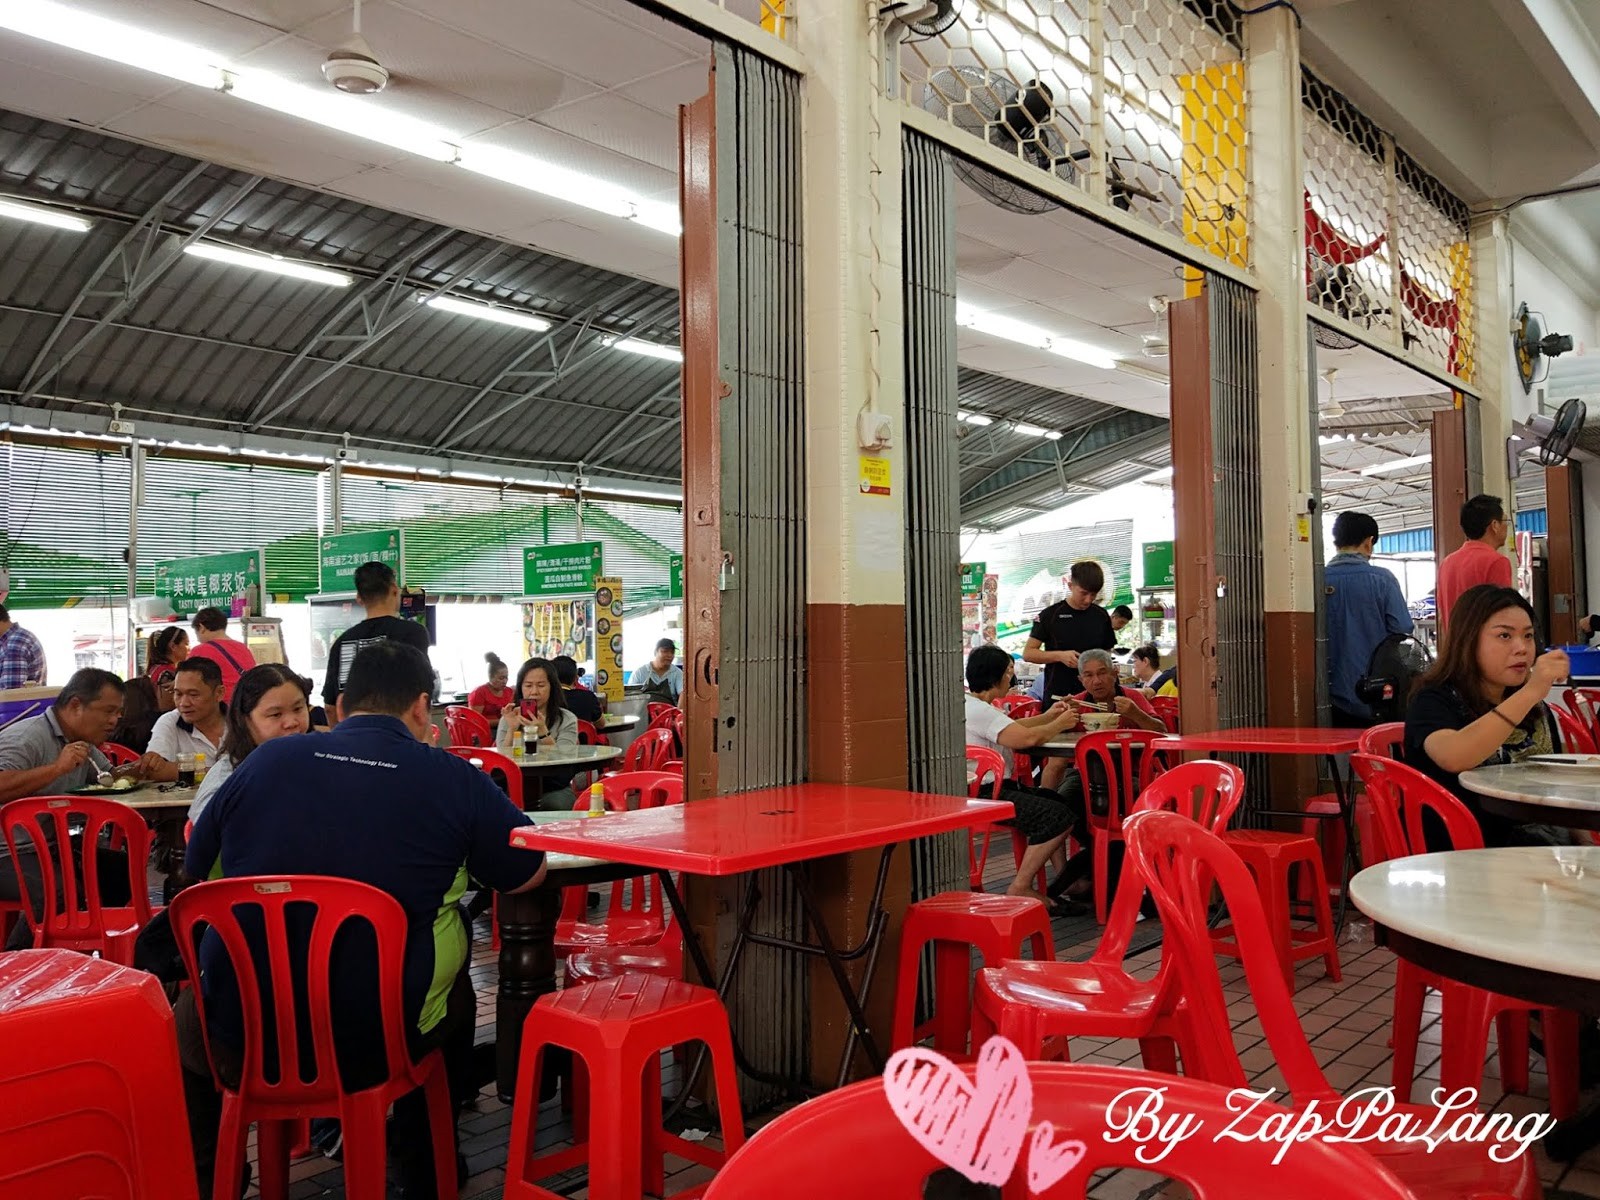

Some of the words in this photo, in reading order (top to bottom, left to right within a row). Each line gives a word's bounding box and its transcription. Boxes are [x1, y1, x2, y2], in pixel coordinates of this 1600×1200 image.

[173, 571, 246, 597] 美味皇椰浆饭
[178, 599, 193, 609] TASTY
[194, 598, 210, 608] QUEEN
[211, 597, 224, 607] NASI
[326, 753, 349, 761] Strategic
[349, 756, 377, 765] Technology
